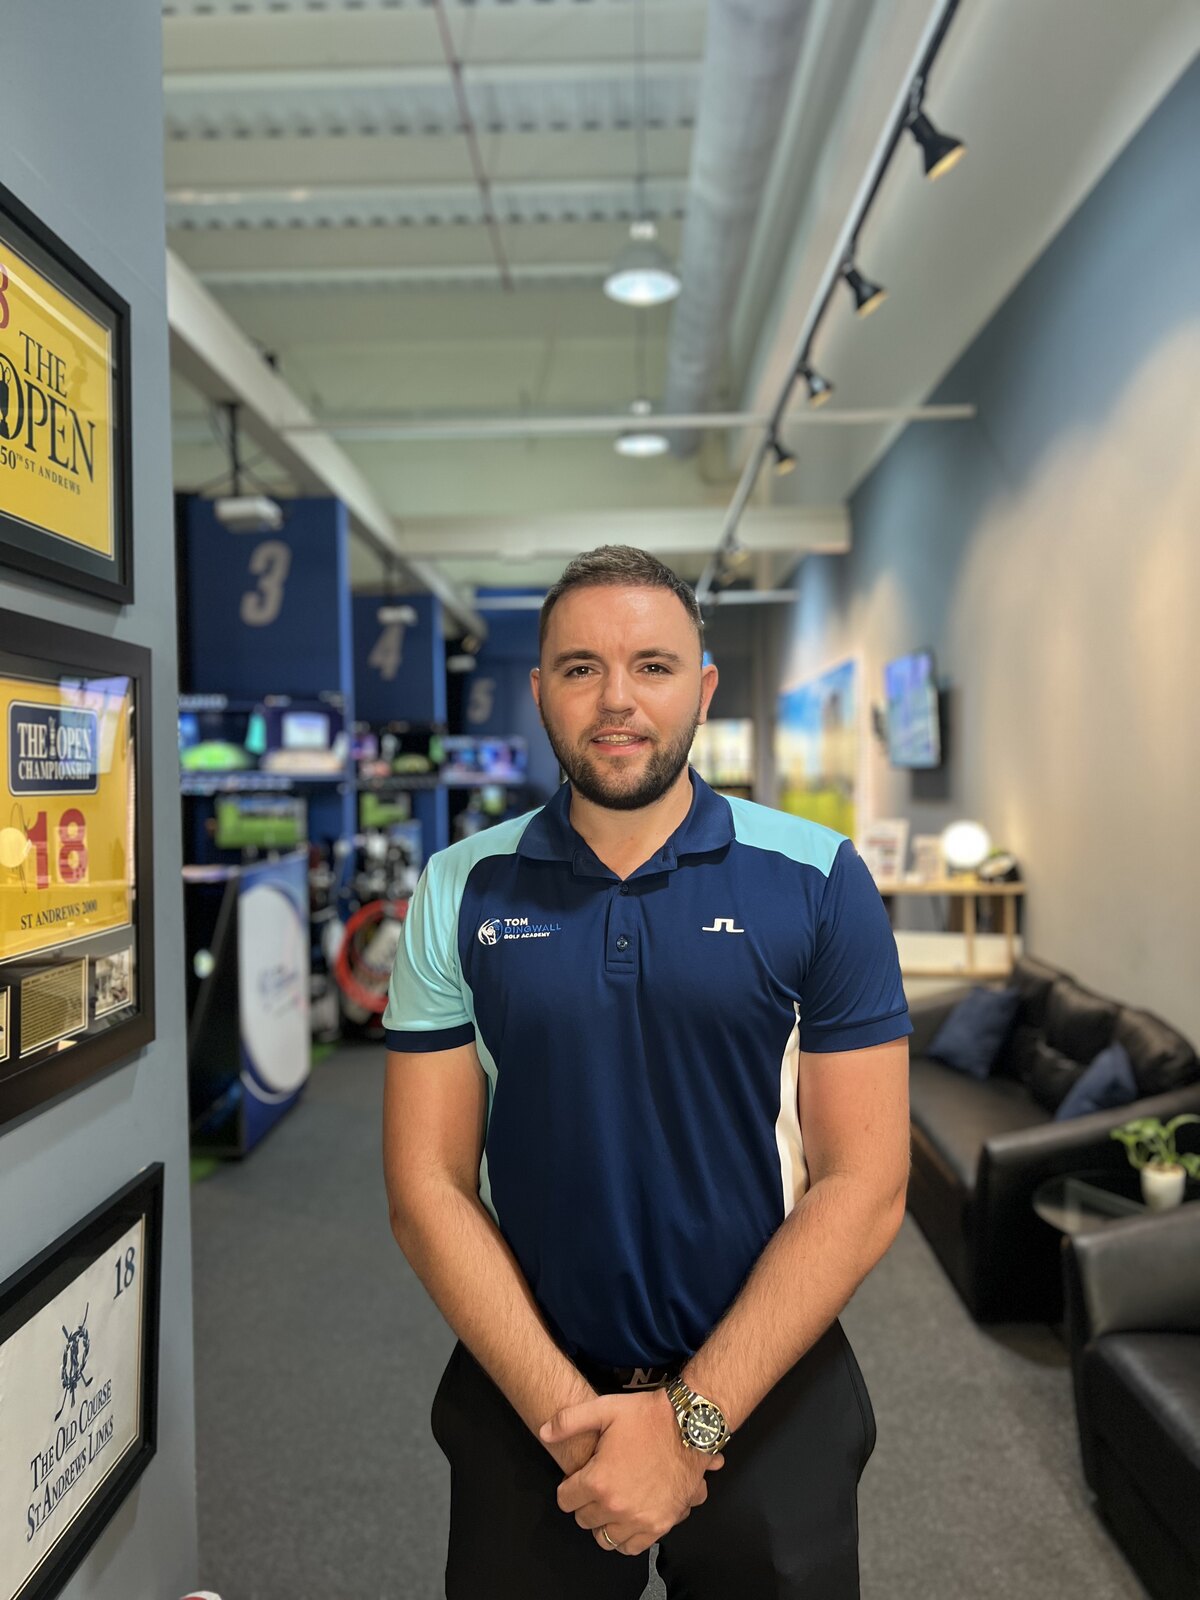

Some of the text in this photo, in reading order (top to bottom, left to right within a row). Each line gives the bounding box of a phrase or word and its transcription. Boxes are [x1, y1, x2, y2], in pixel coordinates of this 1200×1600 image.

[19, 330, 67, 398] THE
[0, 352, 96, 483] OPEN
[24, 458, 36, 473] ST
[38, 465, 81, 495] ANDREWS
[240, 541, 291, 627] 3
[17, 722, 92, 760] THE OPEN
[18, 760, 92, 780] CHAMPIONSHIP
[27, 808, 88, 890] 18
[20, 899, 97, 930] ST ANDREWS 2000
[504, 918, 528, 926] TOM
[504, 923, 561, 933] DINGWALL
[113, 1246, 136, 1300] 18
[31, 1378, 112, 1492] THE OLD COURSE
[27, 1414, 114, 1543] ST ANDREWS LINKS
